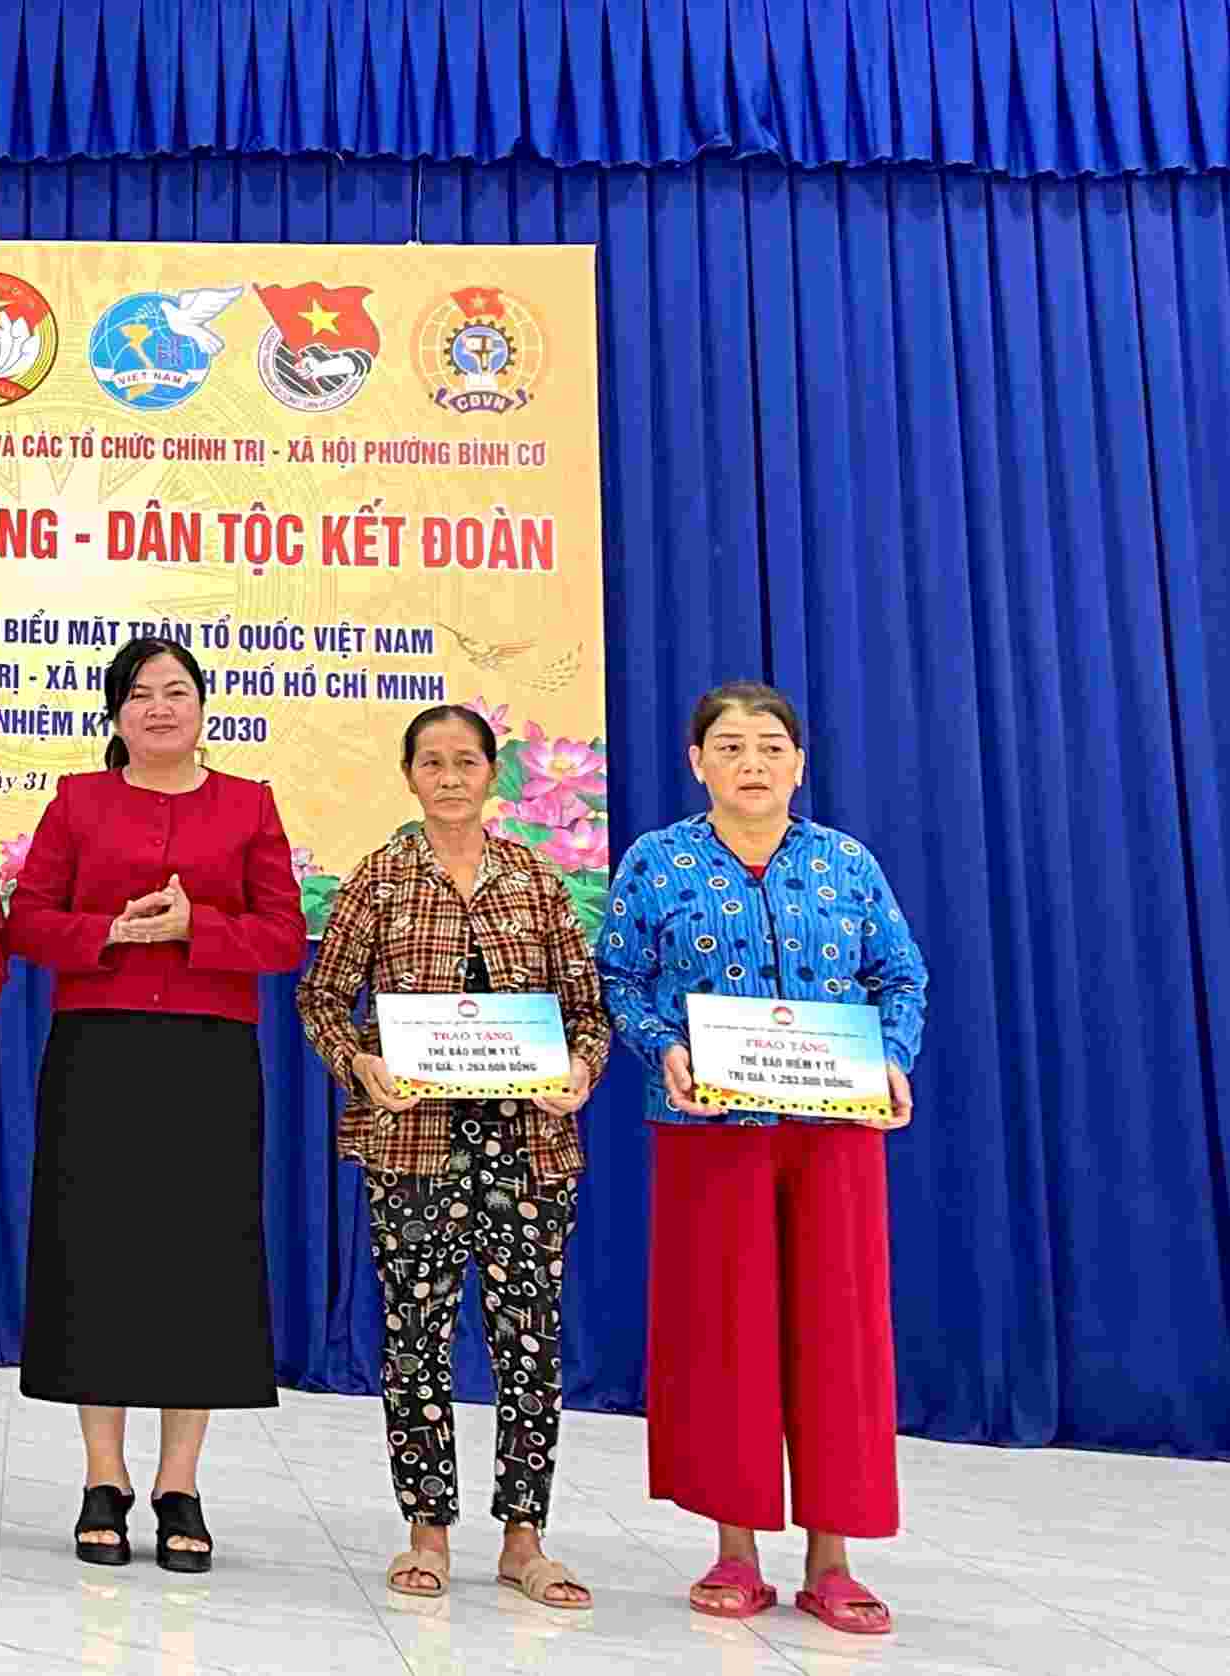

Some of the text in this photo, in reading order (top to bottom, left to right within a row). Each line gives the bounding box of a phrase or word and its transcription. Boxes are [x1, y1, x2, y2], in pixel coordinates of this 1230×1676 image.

[154, 372, 182, 383] NAM
[22, 431, 62, 458] CÁC
[69, 427, 95, 458] TỔ
[101, 433, 155, 460] CHỨC
[163, 433, 226, 462] CHÍNH
[234, 438, 265, 467] TRỊ
[288, 436, 315, 463] XÃ
[322, 437, 355, 469] HỘI
[364, 435, 450, 465] PHƯỜNG
[458, 436, 508, 466] BÌNH
[516, 440, 546, 467] CƠ
[108, 500, 202, 562] DÂN
[218, 502, 304, 576] TỘC
[322, 499, 406, 567] KẾT
[422, 507, 553, 570] ĐOÀN
[4, 609, 59, 644] BIỂU
[68, 616, 120, 651] MẶT
[200, 615, 230, 649] TỔ
[238, 617, 305, 652] QUỐC
[313, 622, 366, 659] VIỆT
[374, 628, 433, 654] NAM
[46, 661, 78, 690] XÃ
[225, 662, 274, 696] PHỐ
[284, 664, 316, 697] HỒ
[326, 669, 367, 698] CHÍ
[377, 674, 444, 700] MINH
[207, 716, 267, 742] 2030
[24, 771, 48, 790] 31
